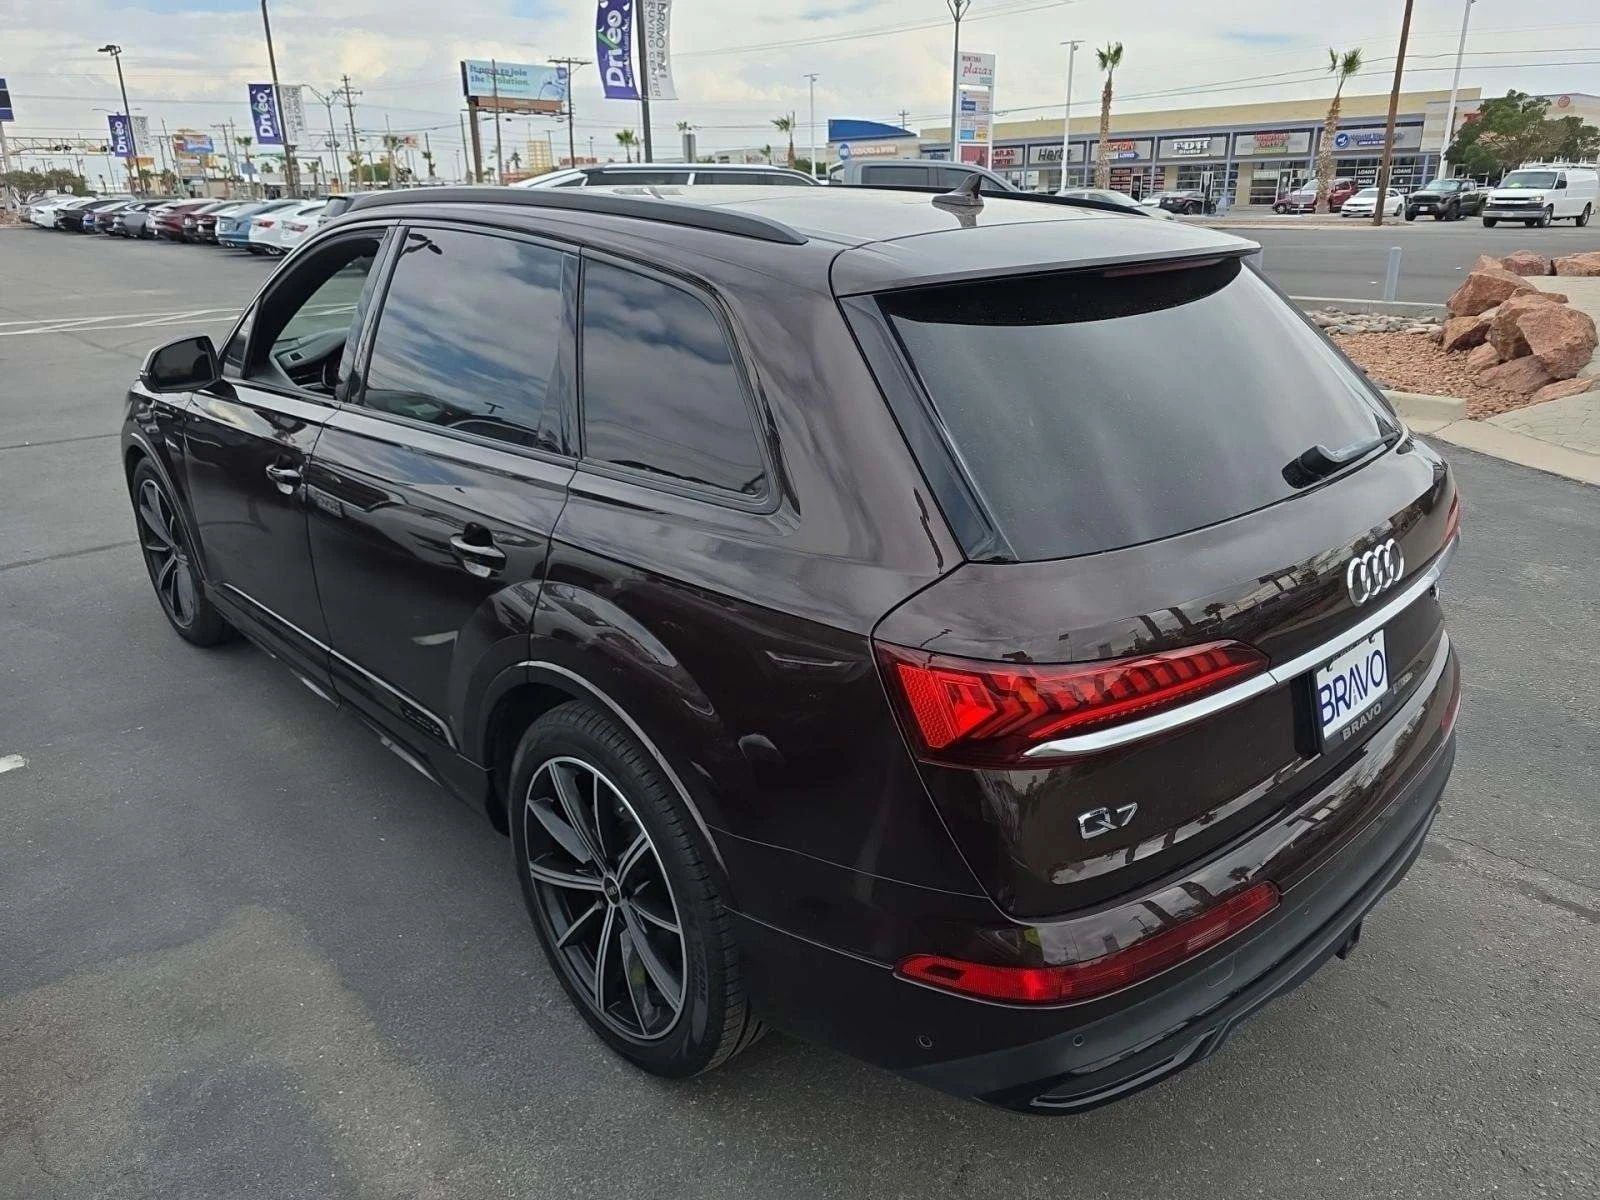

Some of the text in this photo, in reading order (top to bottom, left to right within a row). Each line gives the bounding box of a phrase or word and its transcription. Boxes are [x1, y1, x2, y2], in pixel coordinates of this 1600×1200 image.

[1318, 649, 1385, 728] BRAVO
[1343, 702, 1382, 741] BRAVO
[1078, 802, 1138, 839] Q7
